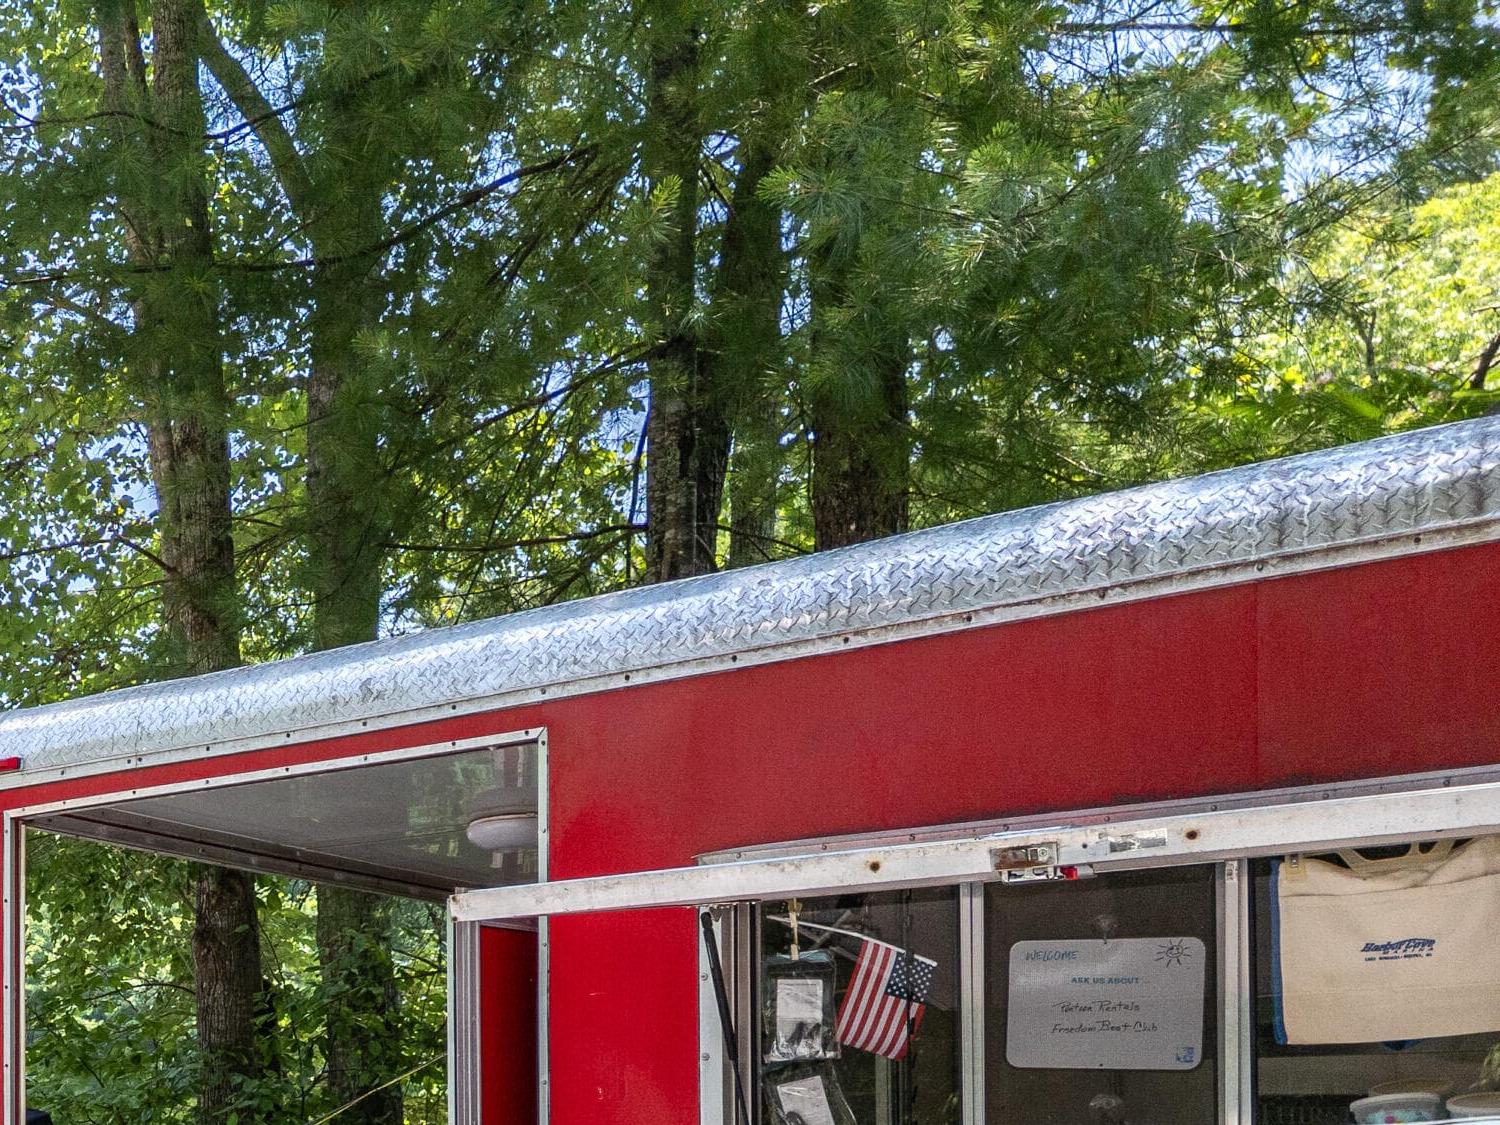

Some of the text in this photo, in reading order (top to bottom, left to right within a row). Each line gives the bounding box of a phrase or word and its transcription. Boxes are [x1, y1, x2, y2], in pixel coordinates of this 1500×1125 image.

[1025, 950, 1079, 962] WELCOME
[1092, 1000, 1141, 1012] Rentals
[1052, 1020, 1158, 1034] Freedom Boat Club
